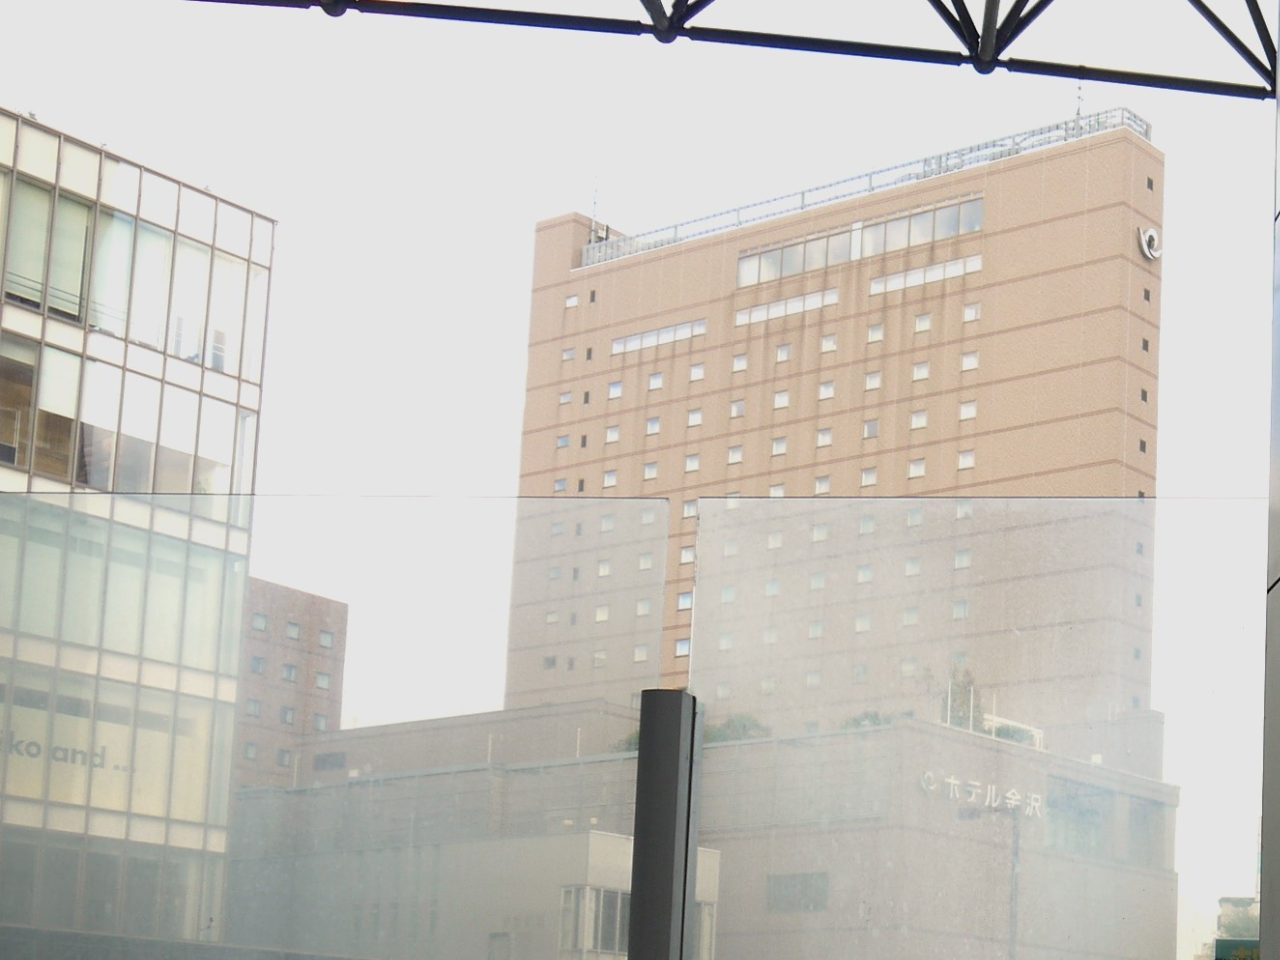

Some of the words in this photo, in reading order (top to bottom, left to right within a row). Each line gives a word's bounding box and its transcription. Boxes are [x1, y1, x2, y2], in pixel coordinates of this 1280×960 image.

[0, 729, 42, 759] ko
[944, 775, 1046, 818] ホテル金沢
